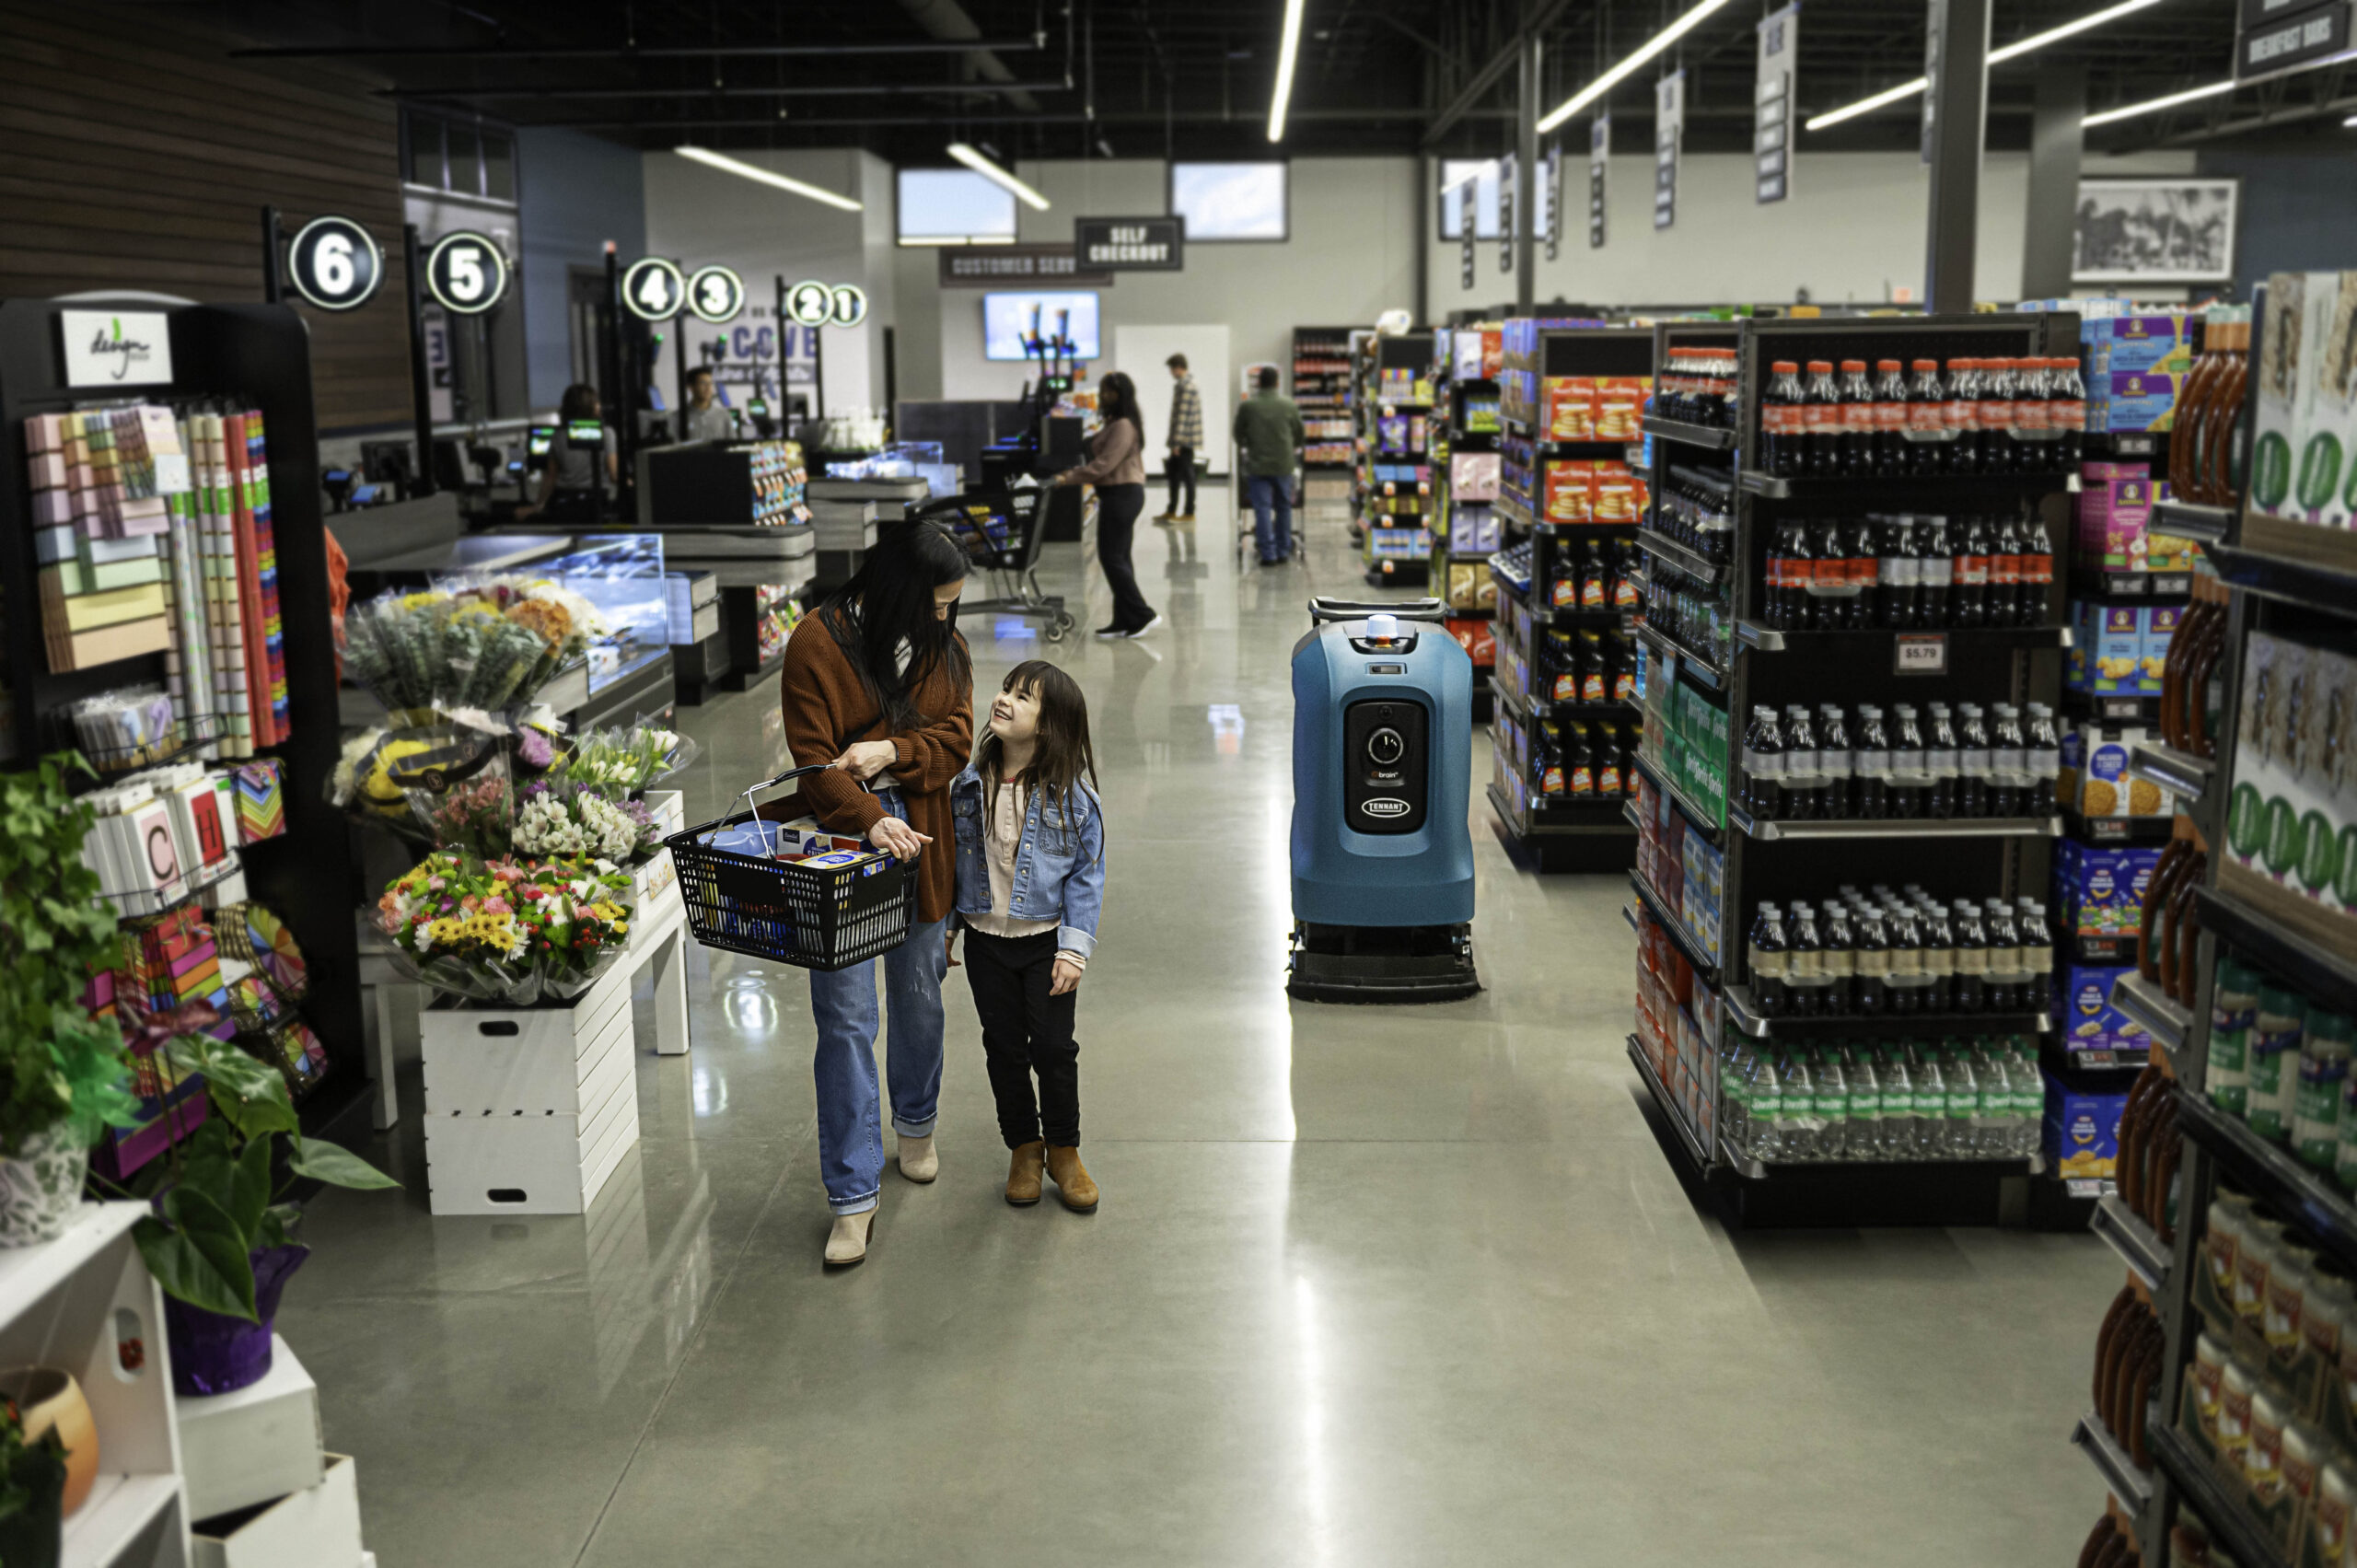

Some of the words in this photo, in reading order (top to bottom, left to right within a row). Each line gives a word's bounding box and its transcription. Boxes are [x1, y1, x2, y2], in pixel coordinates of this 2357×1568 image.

[1110, 227, 1147, 243] SELF
[313, 233, 354, 295] 6
[952, 256, 1033, 274] CUSTOMER
[1038, 255, 1075, 274] SERV
[1089, 245, 1168, 261] CHECKOUT
[449, 248, 484, 301] 5
[639, 268, 668, 310] 4
[701, 274, 729, 314] 3
[799, 286, 822, 320] 2
[836, 290, 851, 321] 1
[1905, 647, 1937, 659] $5.79
[1368, 803, 1404, 812] TENNANT
[195, 808, 217, 854] H
[147, 825, 174, 880] C
